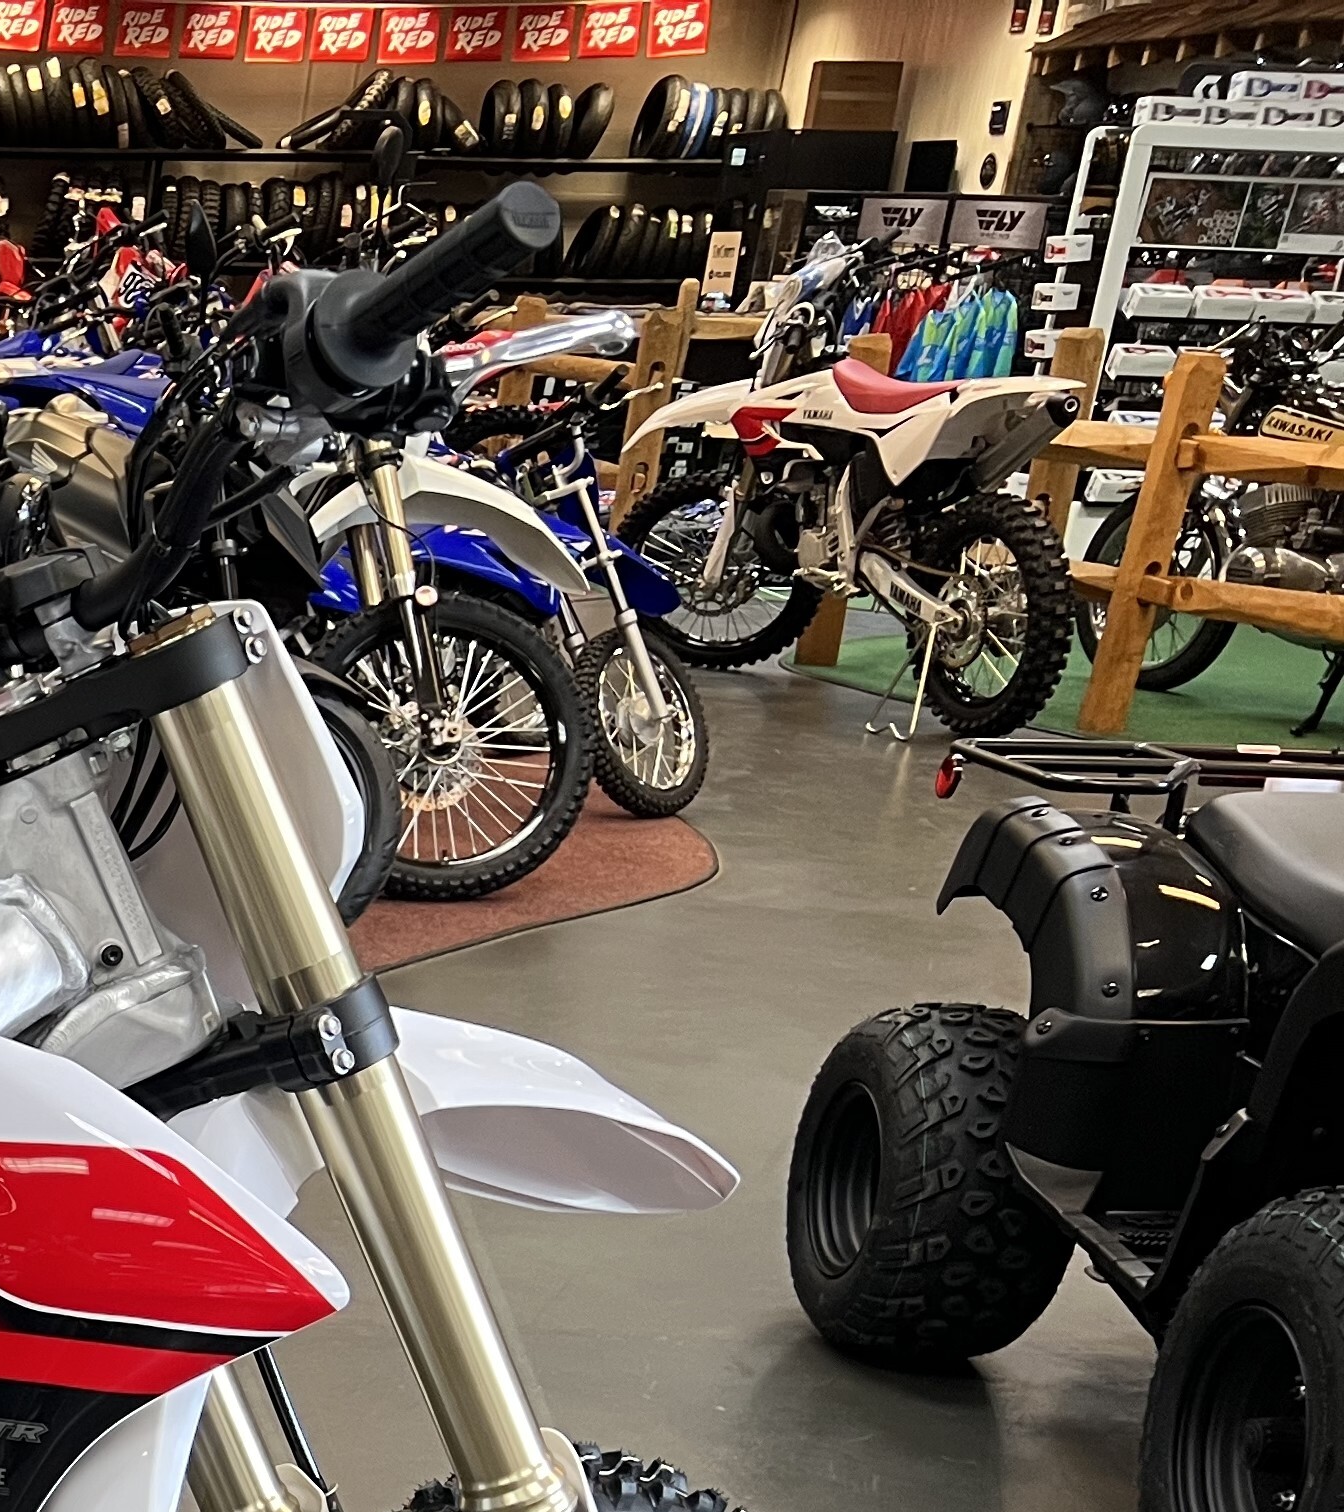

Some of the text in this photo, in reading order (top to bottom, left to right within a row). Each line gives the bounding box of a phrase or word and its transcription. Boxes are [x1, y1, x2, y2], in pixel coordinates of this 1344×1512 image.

[56, 6, 99, 23] RIDE
[123, 9, 165, 26] RIDE
[187, 11, 230, 29] RIDE
[254, 12, 297, 32] RIDE
[318, 13, 363, 32] RIDE
[386, 12, 430, 32] RIDE
[453, 12, 498, 31] RIDE
[520, 11, 564, 30] RIDE
[586, 7, 632, 28] RIDE
[654, 4, 699, 26] RIDE
[58, 23, 103, 46] RED
[124, 25, 169, 48] RED
[188, 28, 235, 52] RED
[255, 29, 302, 53] RED
[320, 30, 366, 55] RED
[388, 30, 435, 55] RED
[455, 30, 501, 54] RED
[521, 28, 569, 52] RED
[587, 25, 636, 50] RED
[657, 22, 704, 47] RED
[976, 209, 1025, 231] FLY
[802, 410, 833, 420] YAMAHA
[1265, 416, 1334, 442] KAWASAKI
